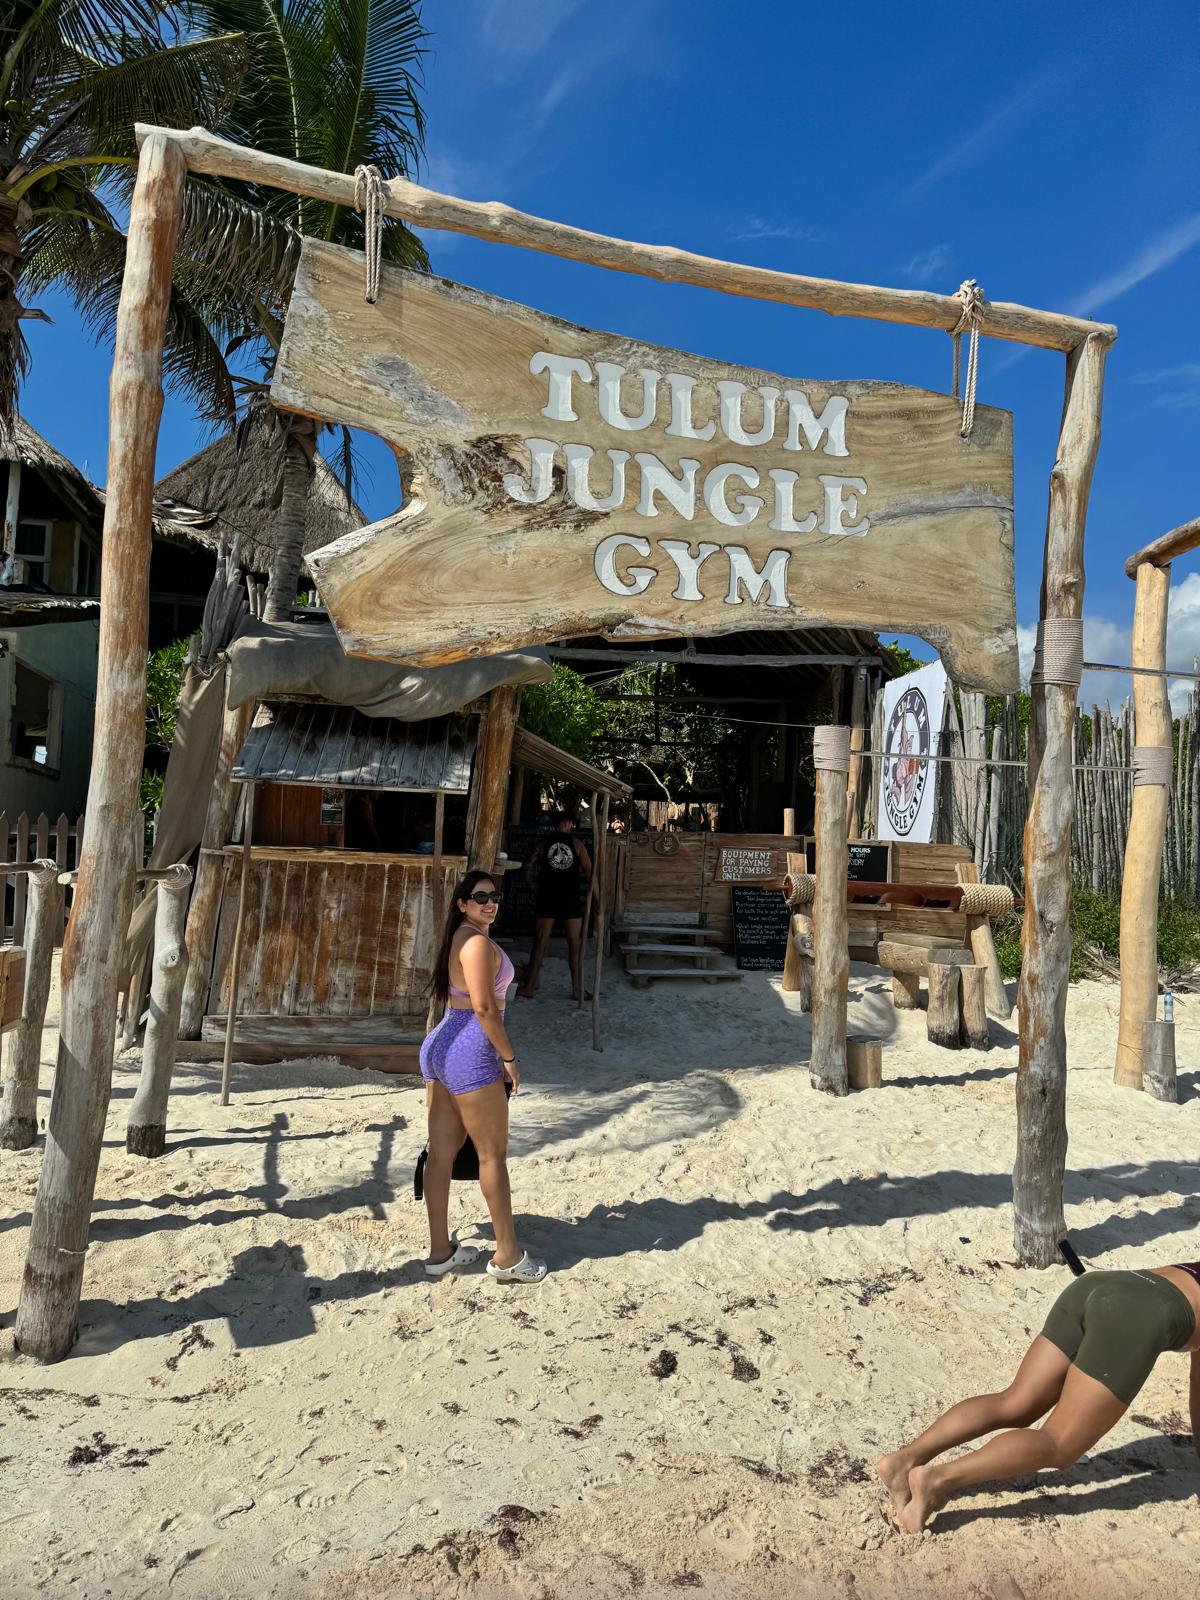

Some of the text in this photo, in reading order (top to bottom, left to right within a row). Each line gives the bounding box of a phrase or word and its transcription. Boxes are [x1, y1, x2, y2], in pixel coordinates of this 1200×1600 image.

[529, 351, 849, 457] TULUM
[503, 437, 870, 537] JUNGLE
[594, 533, 791, 608] GYM
[722, 850, 772, 859] EQUIPMENT
[722, 858, 770, 867] FOR PAYING
[722, 866, 772, 875] CUSTOMERS
[722, 873, 741, 881] ONLY
